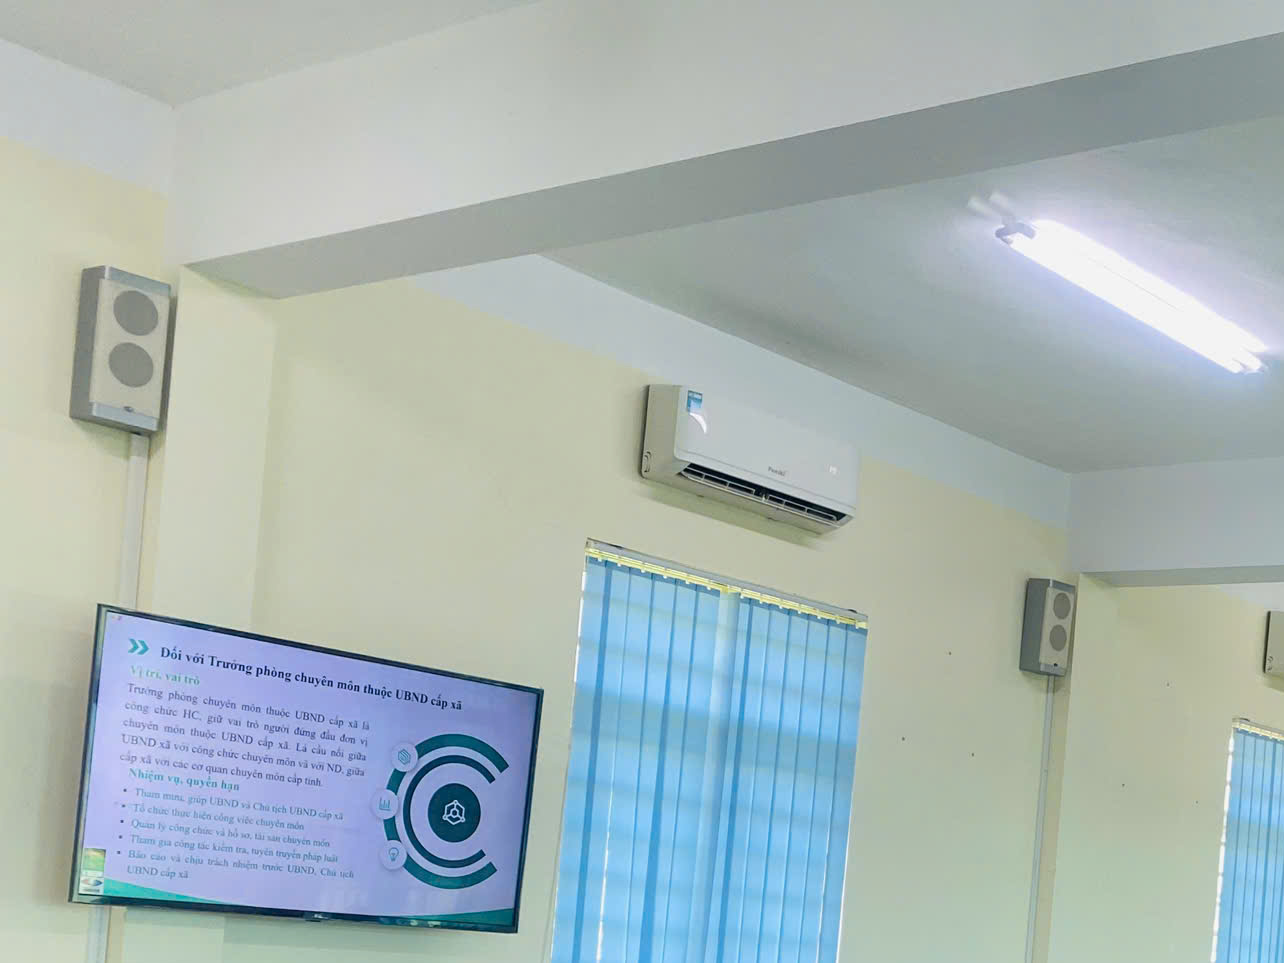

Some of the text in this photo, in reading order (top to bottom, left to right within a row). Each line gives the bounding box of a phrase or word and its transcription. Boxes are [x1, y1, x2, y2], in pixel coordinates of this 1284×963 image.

[160, 647, 462, 709] Đối với Trưởng phòng chuyên môn thuộc UBND cấp xã
[165, 673, 181, 682] vai
[127, 683, 163, 700] Trưởng
[168, 691, 198, 705] phòng
[202, 696, 236, 709] chuyên
[241, 703, 260, 712] môn
[265, 705, 290, 719] thuộc
[295, 710, 325, 722] UBND
[328, 715, 343, 728] cấp
[348, 719, 358, 728] xã
[124, 701, 148, 714] công
[154, 705, 177, 716] chức
[207, 713, 222, 724] giữ
[227, 717, 241, 726] vai
[246, 718, 259, 728] trò
[263, 723, 289, 733] người
[293, 726, 315, 739] đứng
[320, 729, 335, 740] đầu
[339, 733, 355, 743] đơn
[360, 736, 368, 747] vị
[122, 718, 158, 731] chuyên
[164, 725, 185, 734] môn
[190, 727, 216, 740] thuộc
[221, 732, 253, 744] UBND
[257, 736, 273, 749] cấp
[296, 742, 307, 752] Là
[311, 744, 326, 754] cầu
[330, 747, 344, 757] nối
[347, 751, 366, 761] giữa
[119, 751, 136, 764] cấp
[139, 755, 151, 763] xã
[154, 757, 170, 766] với
[172, 759, 188, 768] các
[205, 764, 228, 774] quan
[230, 766, 262, 779] chuyên
[265, 771, 284, 781] môn
[287, 773, 302, 786] cấp
[121, 734, 156, 747] UBND
[159, 740, 170, 749] xã
[173, 742, 189, 751] với
[191, 745, 214, 757] công
[217, 748, 238, 758] chức
[241, 751, 273, 764] chuyên
[276, 757, 296, 766] môn
[298, 759, 308, 768] và
[311, 761, 324, 770] với
[346, 766, 364, 776] giữa
[128, 768, 163, 782] Nhiệm
[186, 776, 217, 788] quyền
[221, 779, 239, 792] hạn
[135, 788, 160, 798] Tham
[187, 794, 206, 805] giúp
[209, 796, 238, 807] UBND
[252, 801, 270, 811] Chủ
[272, 804, 287, 814] tịch
[289, 806, 316, 816] UBND
[318, 808, 331, 820] cấp
[334, 811, 343, 819] xã
[147, 805, 168, 814] chức
[193, 810, 211, 821] hiện
[213, 813, 233, 823] công
[255, 817, 284, 828] chuyên
[287, 821, 304, 829] môn
[130, 834, 155, 844] Tham
[158, 837, 171, 847] gia
[174, 839, 194, 850] công
[251, 846, 273, 857] tuyên
[276, 849, 300, 859] truyền
[303, 852, 321, 862] pháp
[168, 823, 190, 834] công
[282, 835, 310, 845] chuyên
[127, 866, 158, 875] UBND
[160, 868, 175, 879] cấp
[170, 854, 180, 862] và
[184, 855, 203, 865] chịu
